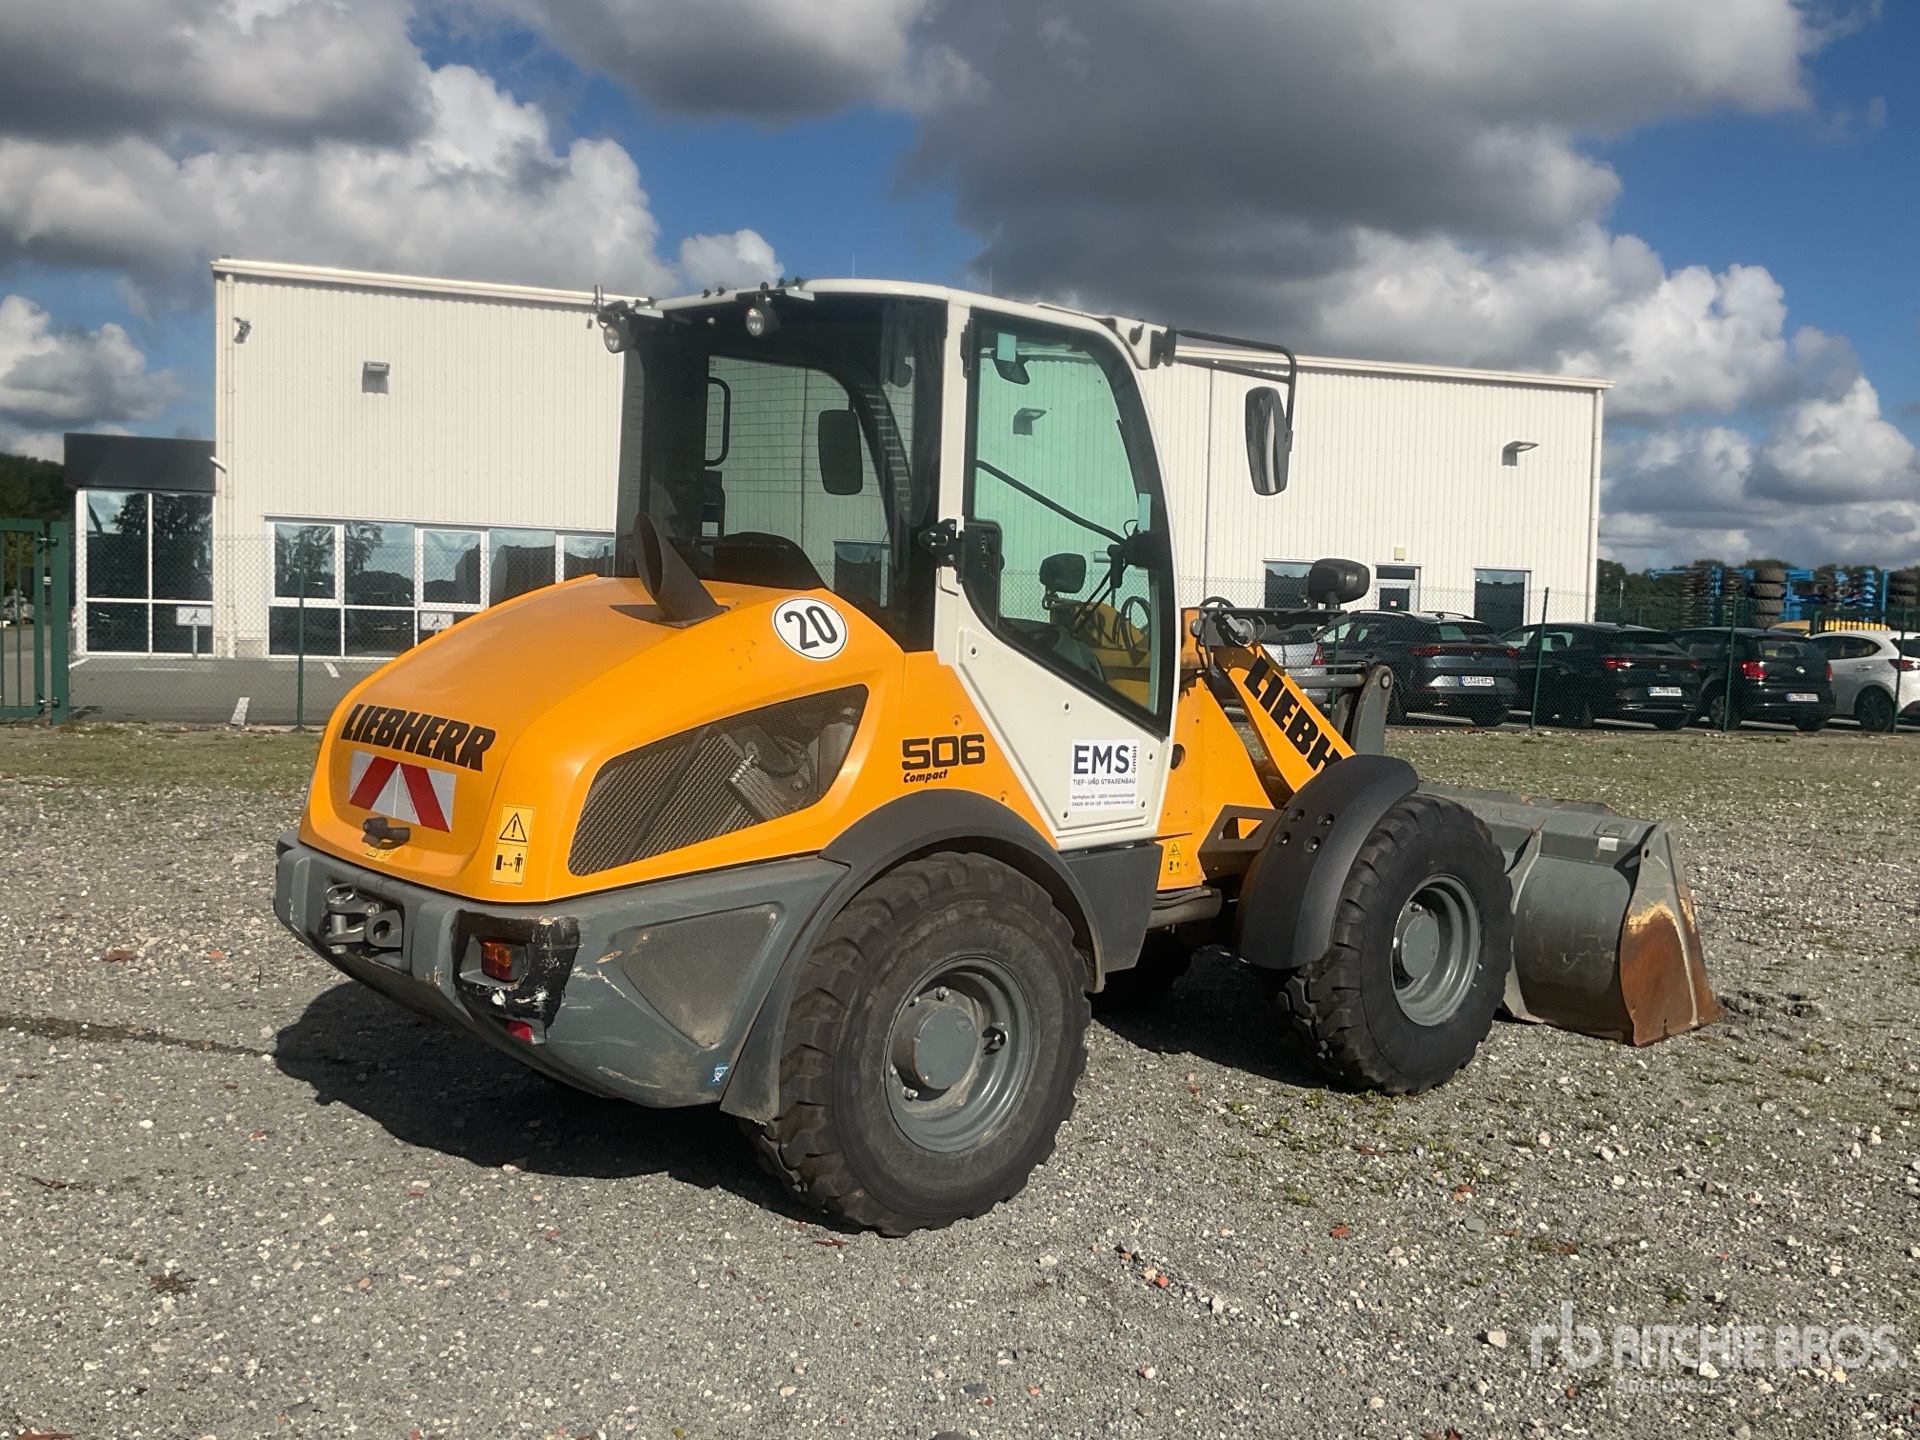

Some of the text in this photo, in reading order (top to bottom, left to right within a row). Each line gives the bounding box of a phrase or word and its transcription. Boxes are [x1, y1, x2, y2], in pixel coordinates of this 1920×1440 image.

[783, 605, 838, 650] 20
[340, 703, 496, 772] LIEBHERR
[902, 733, 985, 770] 506
[903, 769, 948, 783] Compact
[1073, 744, 1130, 775] EMS
[1088, 777, 1100, 786] UND
